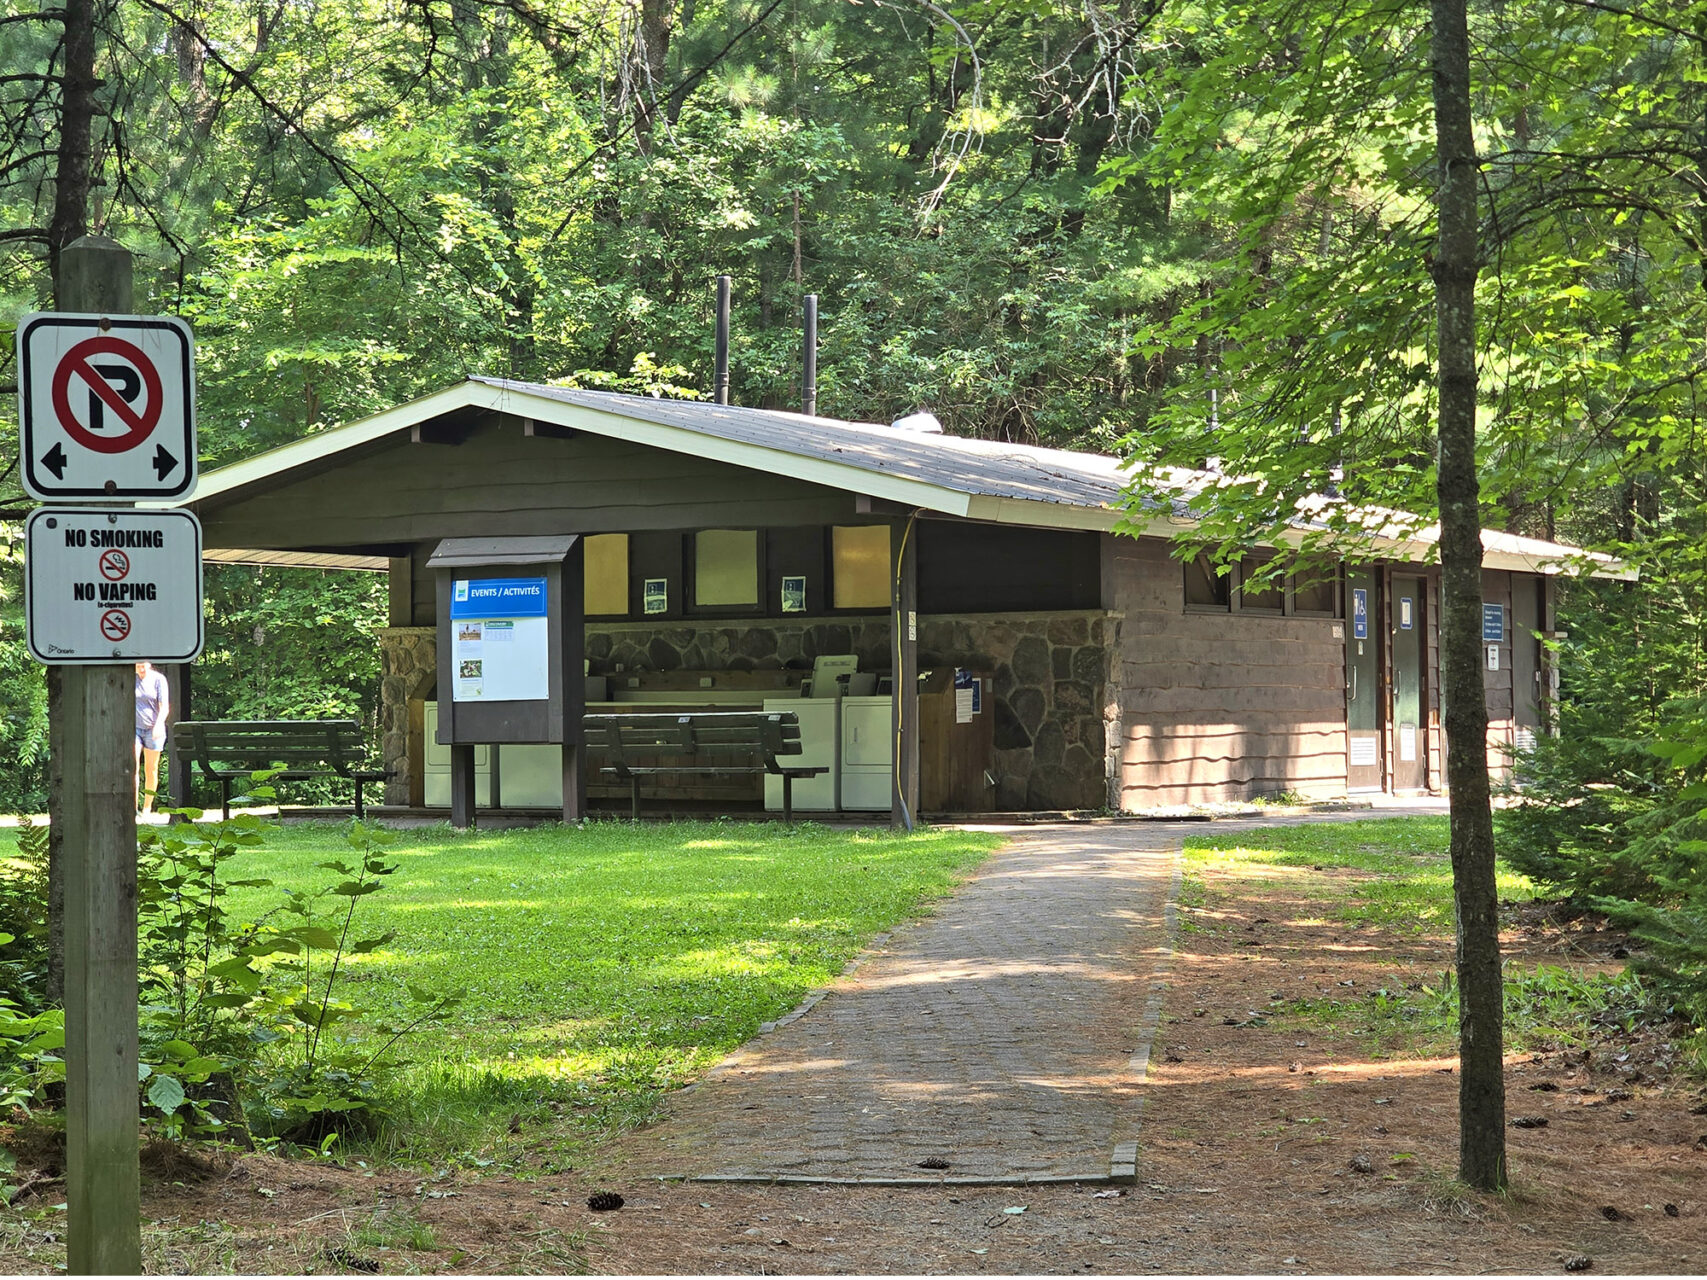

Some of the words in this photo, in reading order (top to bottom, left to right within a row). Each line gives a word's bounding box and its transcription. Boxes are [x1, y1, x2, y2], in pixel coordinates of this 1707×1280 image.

[65, 529, 87, 548] NO
[90, 529, 163, 548] SMOKING
[73, 583, 96, 601] NO
[98, 583, 157, 601] VAPING
[471, 588, 497, 597] EVENTS
[498, 588, 503, 597] /
[503, 586, 540, 596] ACTIVITÉS
